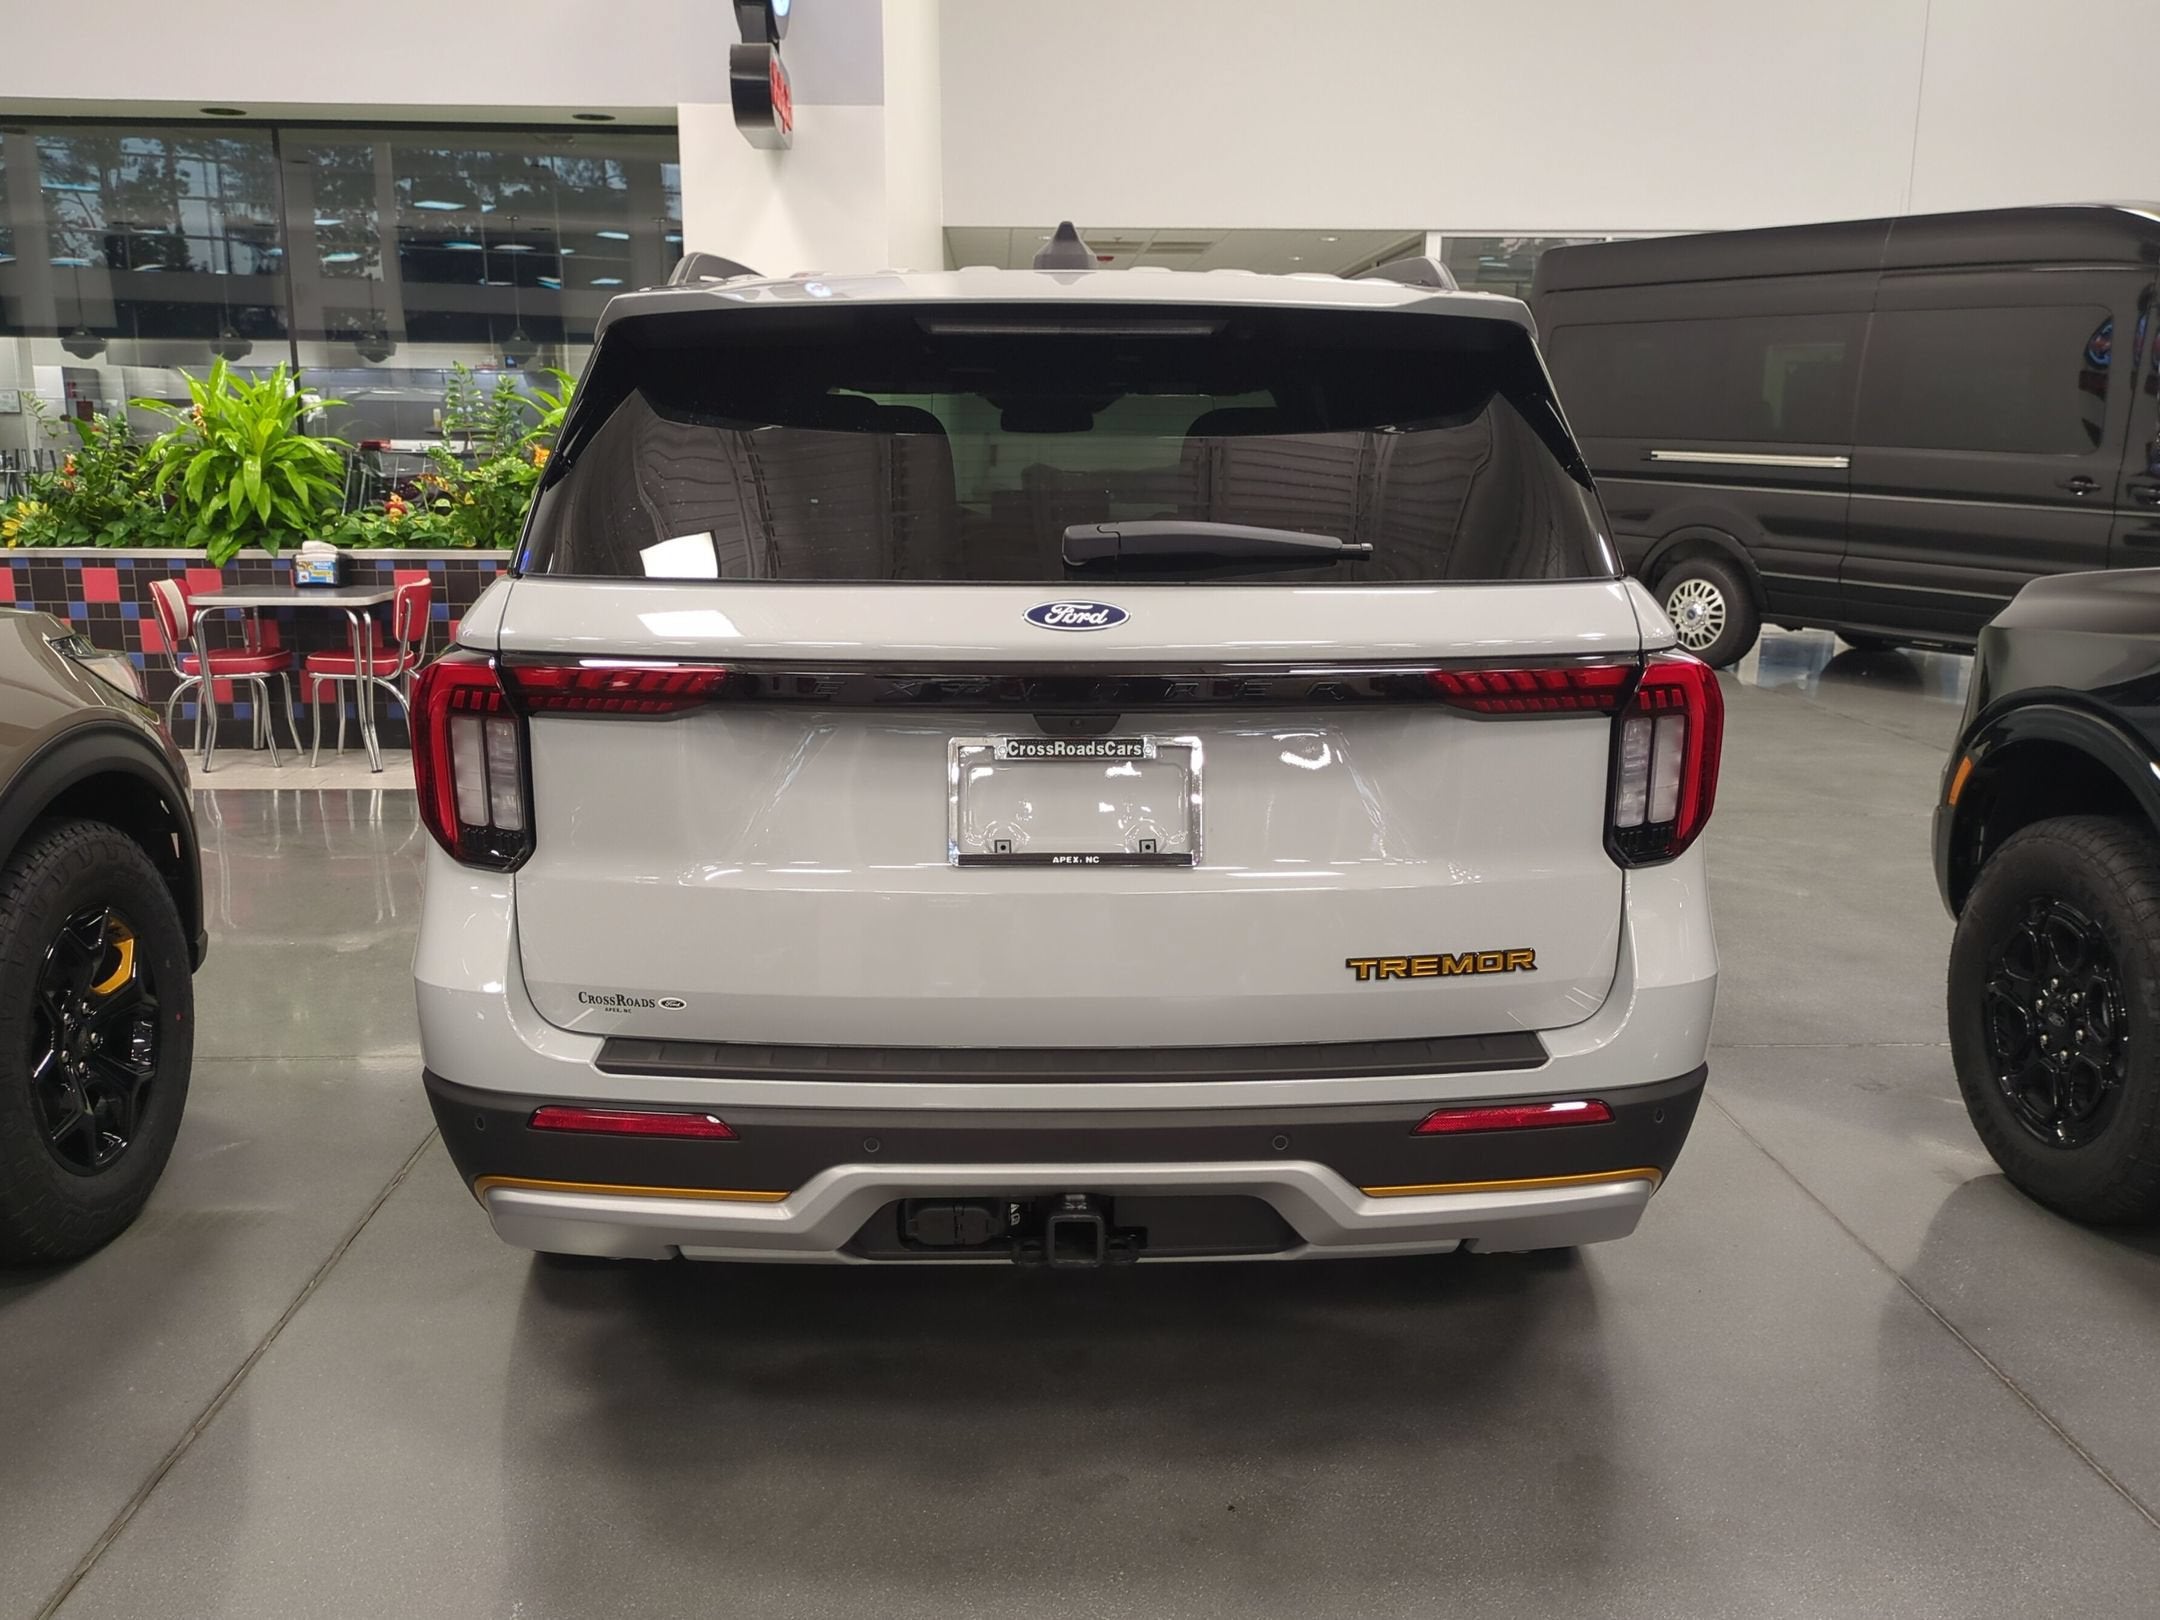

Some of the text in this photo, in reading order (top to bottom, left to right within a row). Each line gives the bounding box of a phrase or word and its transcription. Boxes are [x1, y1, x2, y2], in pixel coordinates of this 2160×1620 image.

[1044, 603, 1109, 624] Ford
[813, 680, 1345, 700] EXPRER
[1007, 740, 1142, 756] CrossRoadsCars
[1052, 856, 1100, 864] APEX, NC
[1346, 948, 1538, 981] TREMOR
